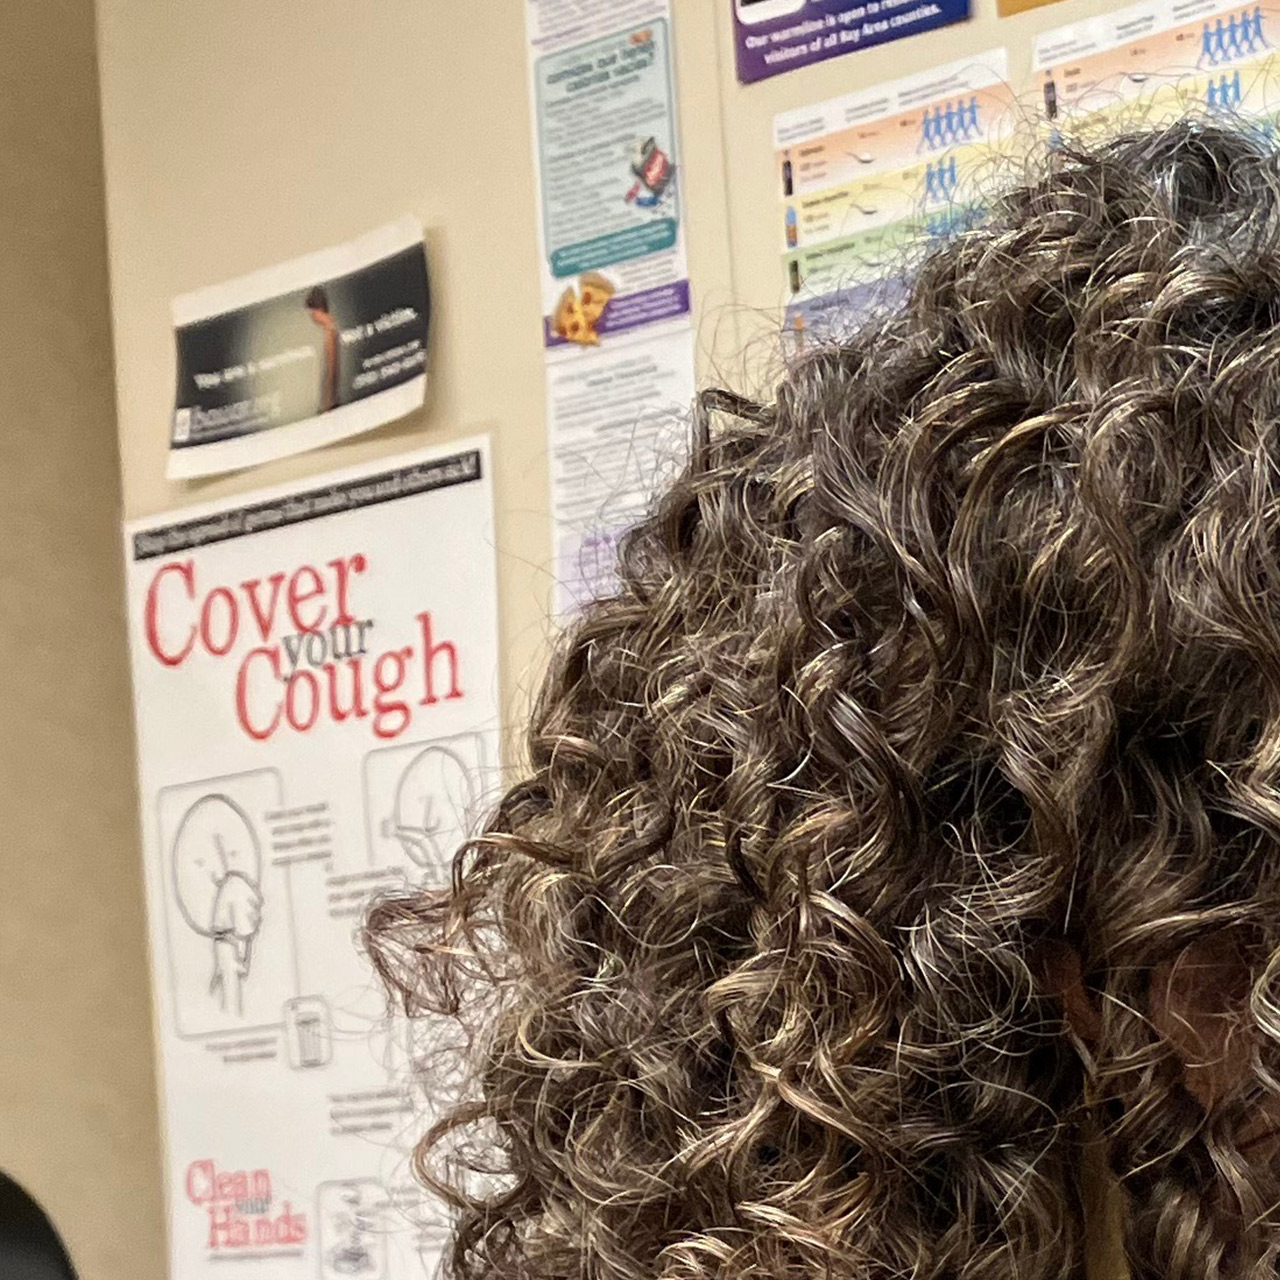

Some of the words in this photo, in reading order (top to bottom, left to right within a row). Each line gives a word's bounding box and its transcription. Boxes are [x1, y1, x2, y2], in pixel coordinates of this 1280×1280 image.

[764, 44, 808, 65] visitors
[809, 37, 822, 51] of
[824, 32, 838, 48] all
[839, 28, 861, 44] Bay
[862, 18, 889, 36] Area
[837, 6, 866, 24] open
[143, 551, 368, 667] Cover
[234, 609, 465, 741] Cough
[281, 618, 375, 683] your
[207, 1200, 309, 1249] Hands
